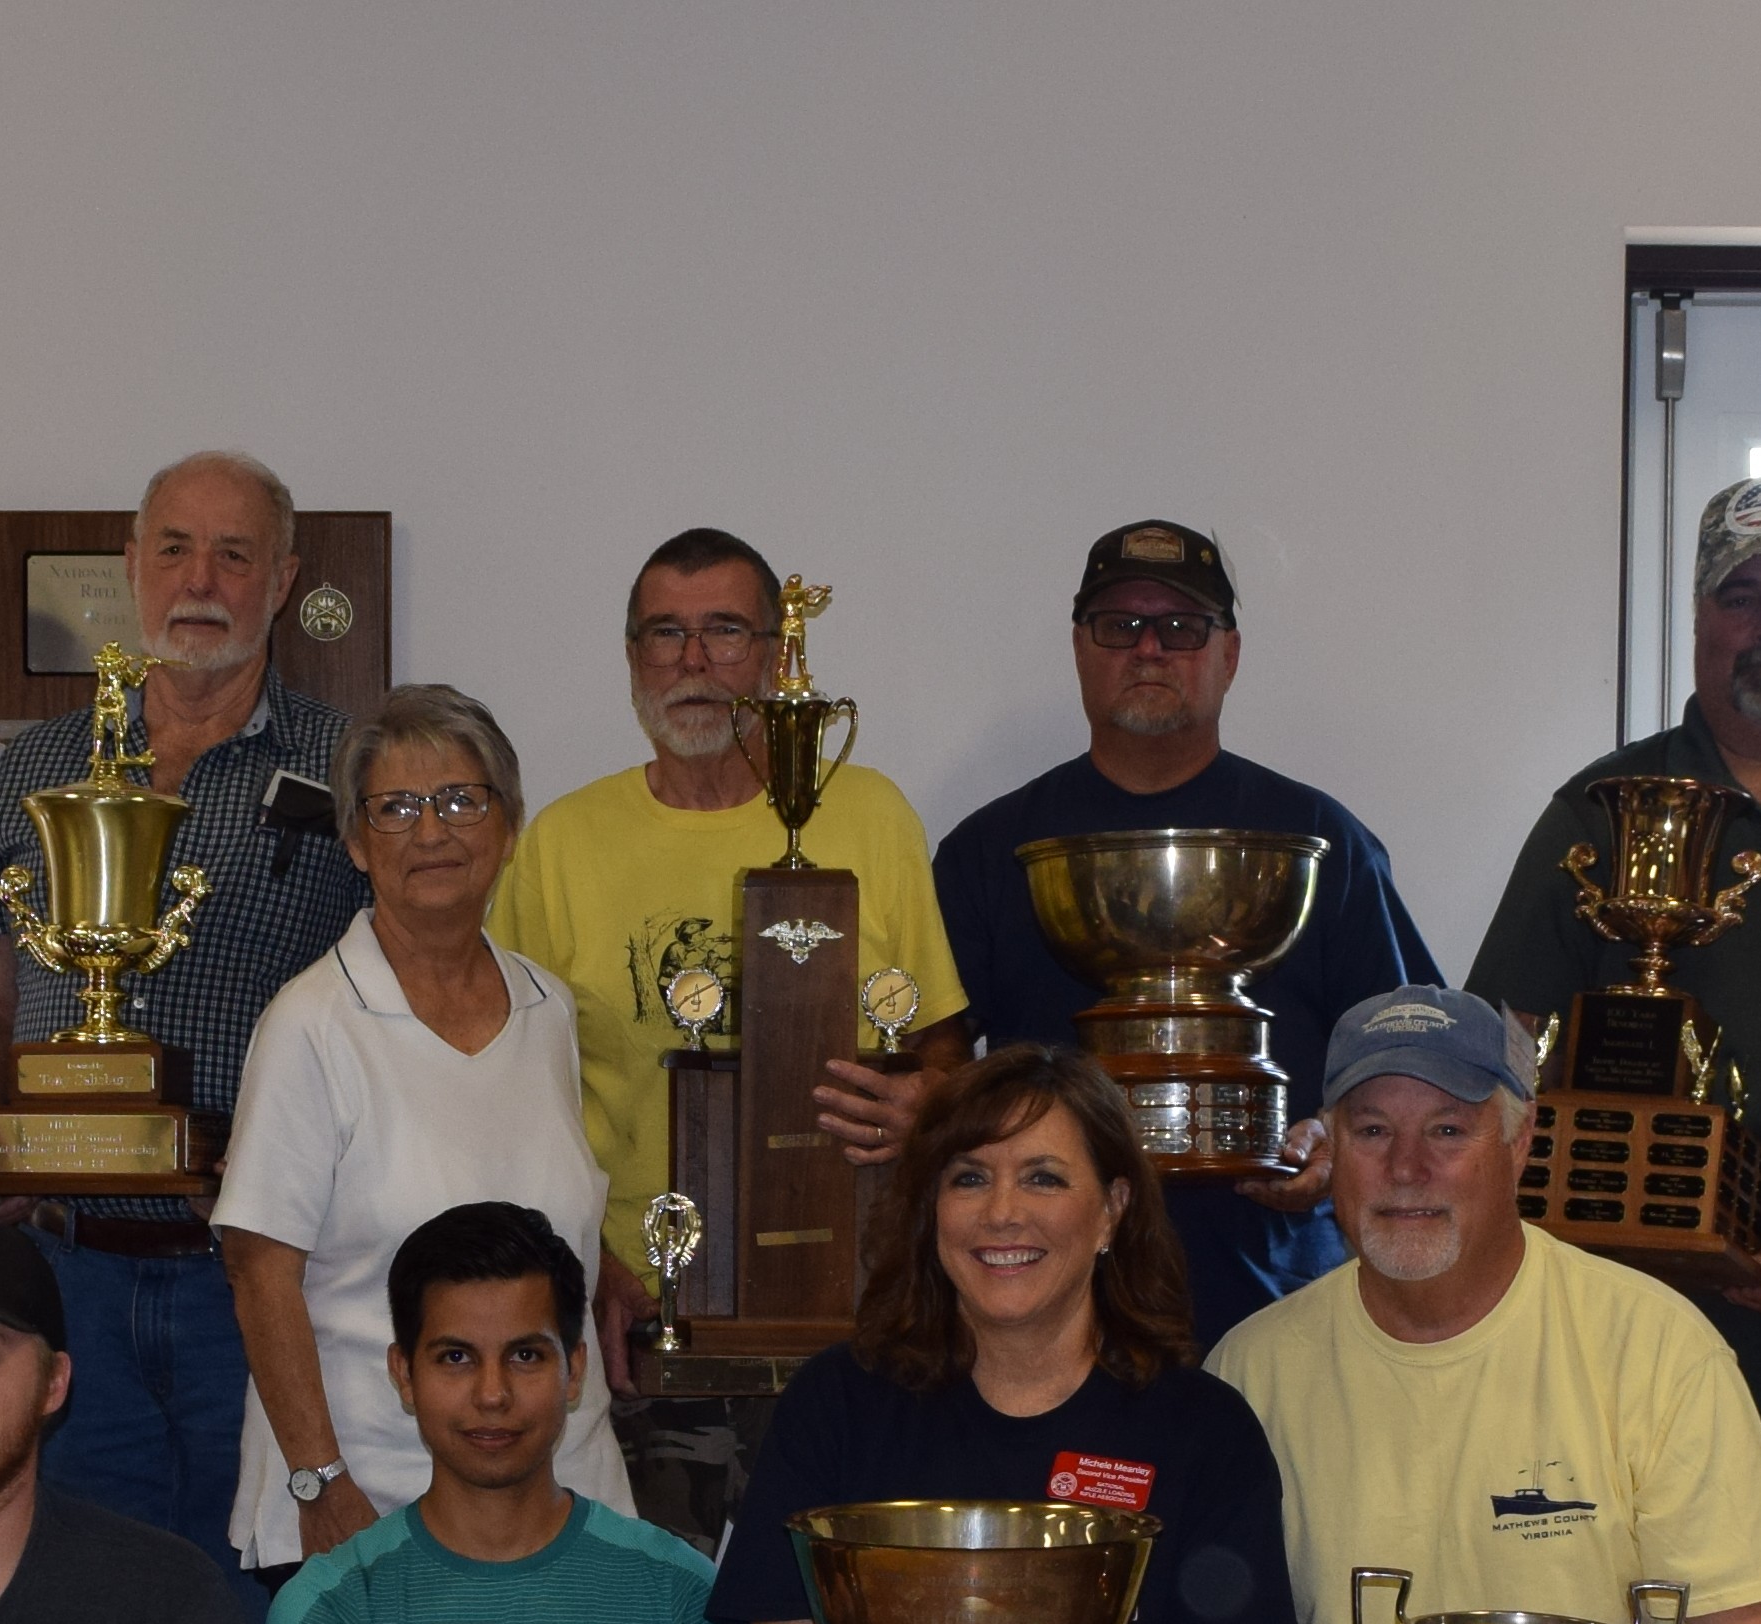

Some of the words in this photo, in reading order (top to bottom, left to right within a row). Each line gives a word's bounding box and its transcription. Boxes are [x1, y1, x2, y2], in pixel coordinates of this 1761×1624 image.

[1079, 1457, 1112, 1470] Michele
[1492, 1518, 1549, 1532] MATHEWS
[1554, 1514, 1597, 1524] COUNTY
[1521, 1528, 1574, 1541] VIRGINIA
